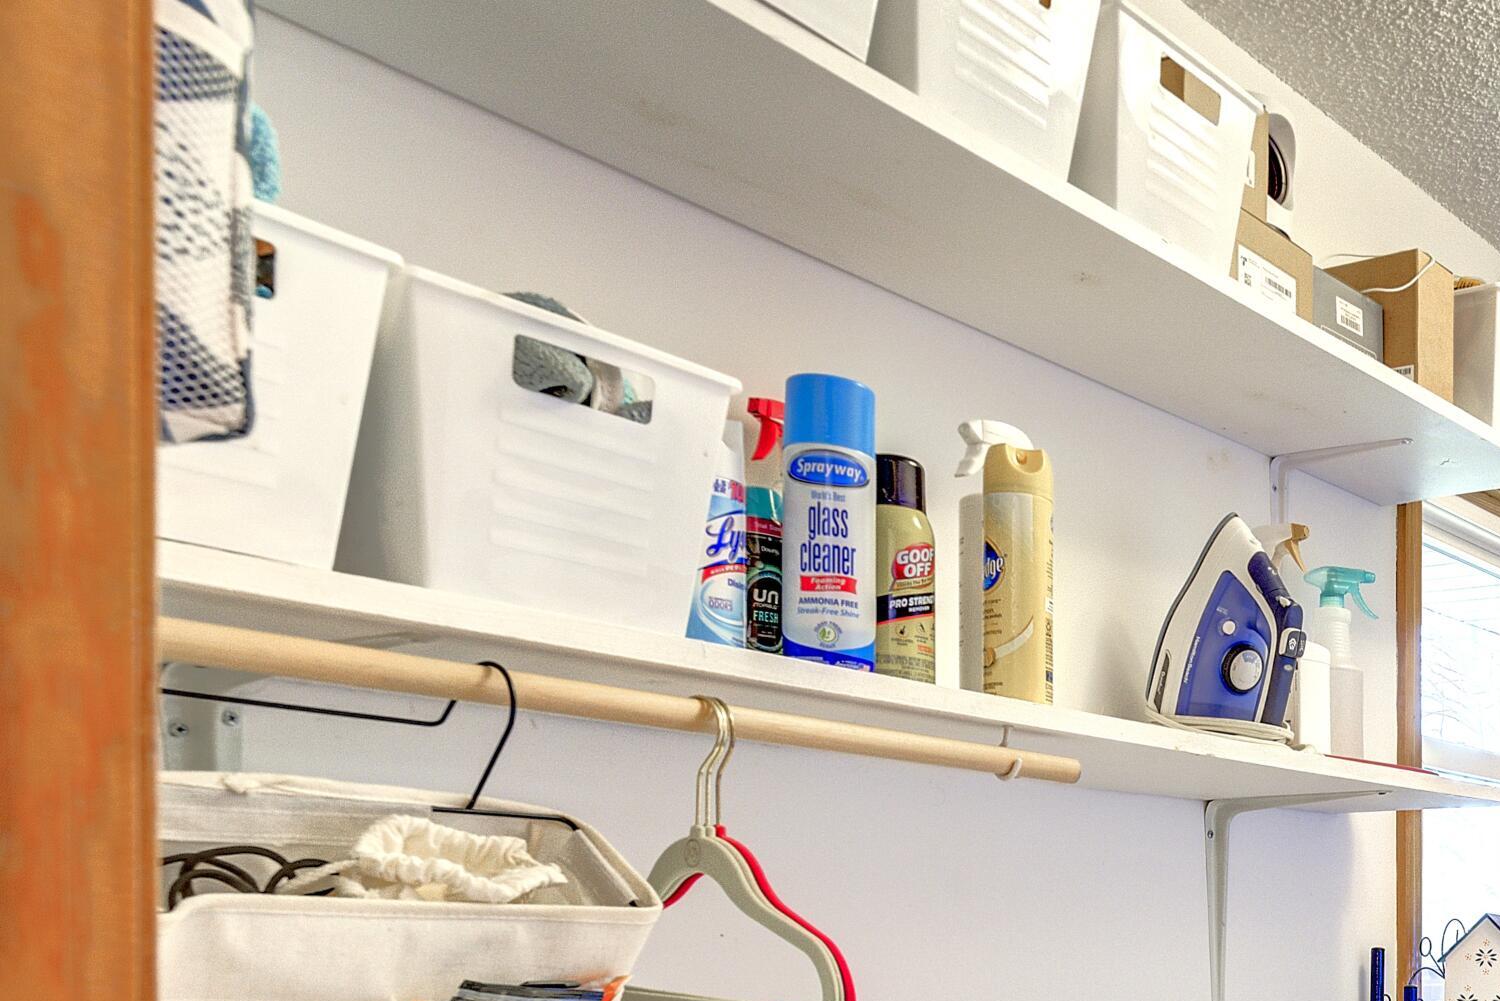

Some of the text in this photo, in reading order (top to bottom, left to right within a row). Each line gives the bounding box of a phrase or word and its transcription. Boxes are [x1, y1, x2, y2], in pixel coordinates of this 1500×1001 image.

[797, 459, 861, 482] Sprayway
[808, 501, 848, 540] glass
[800, 540, 856, 575] cleaner
[904, 562, 931, 578] OFF
[811, 577, 846, 586] Foaming
[799, 596, 858, 609] AMMONIA FREE
[889, 598, 908, 609] PRO
[754, 611, 779, 624] FRESH
[797, 606, 859, 618] Streak-Free Shine
